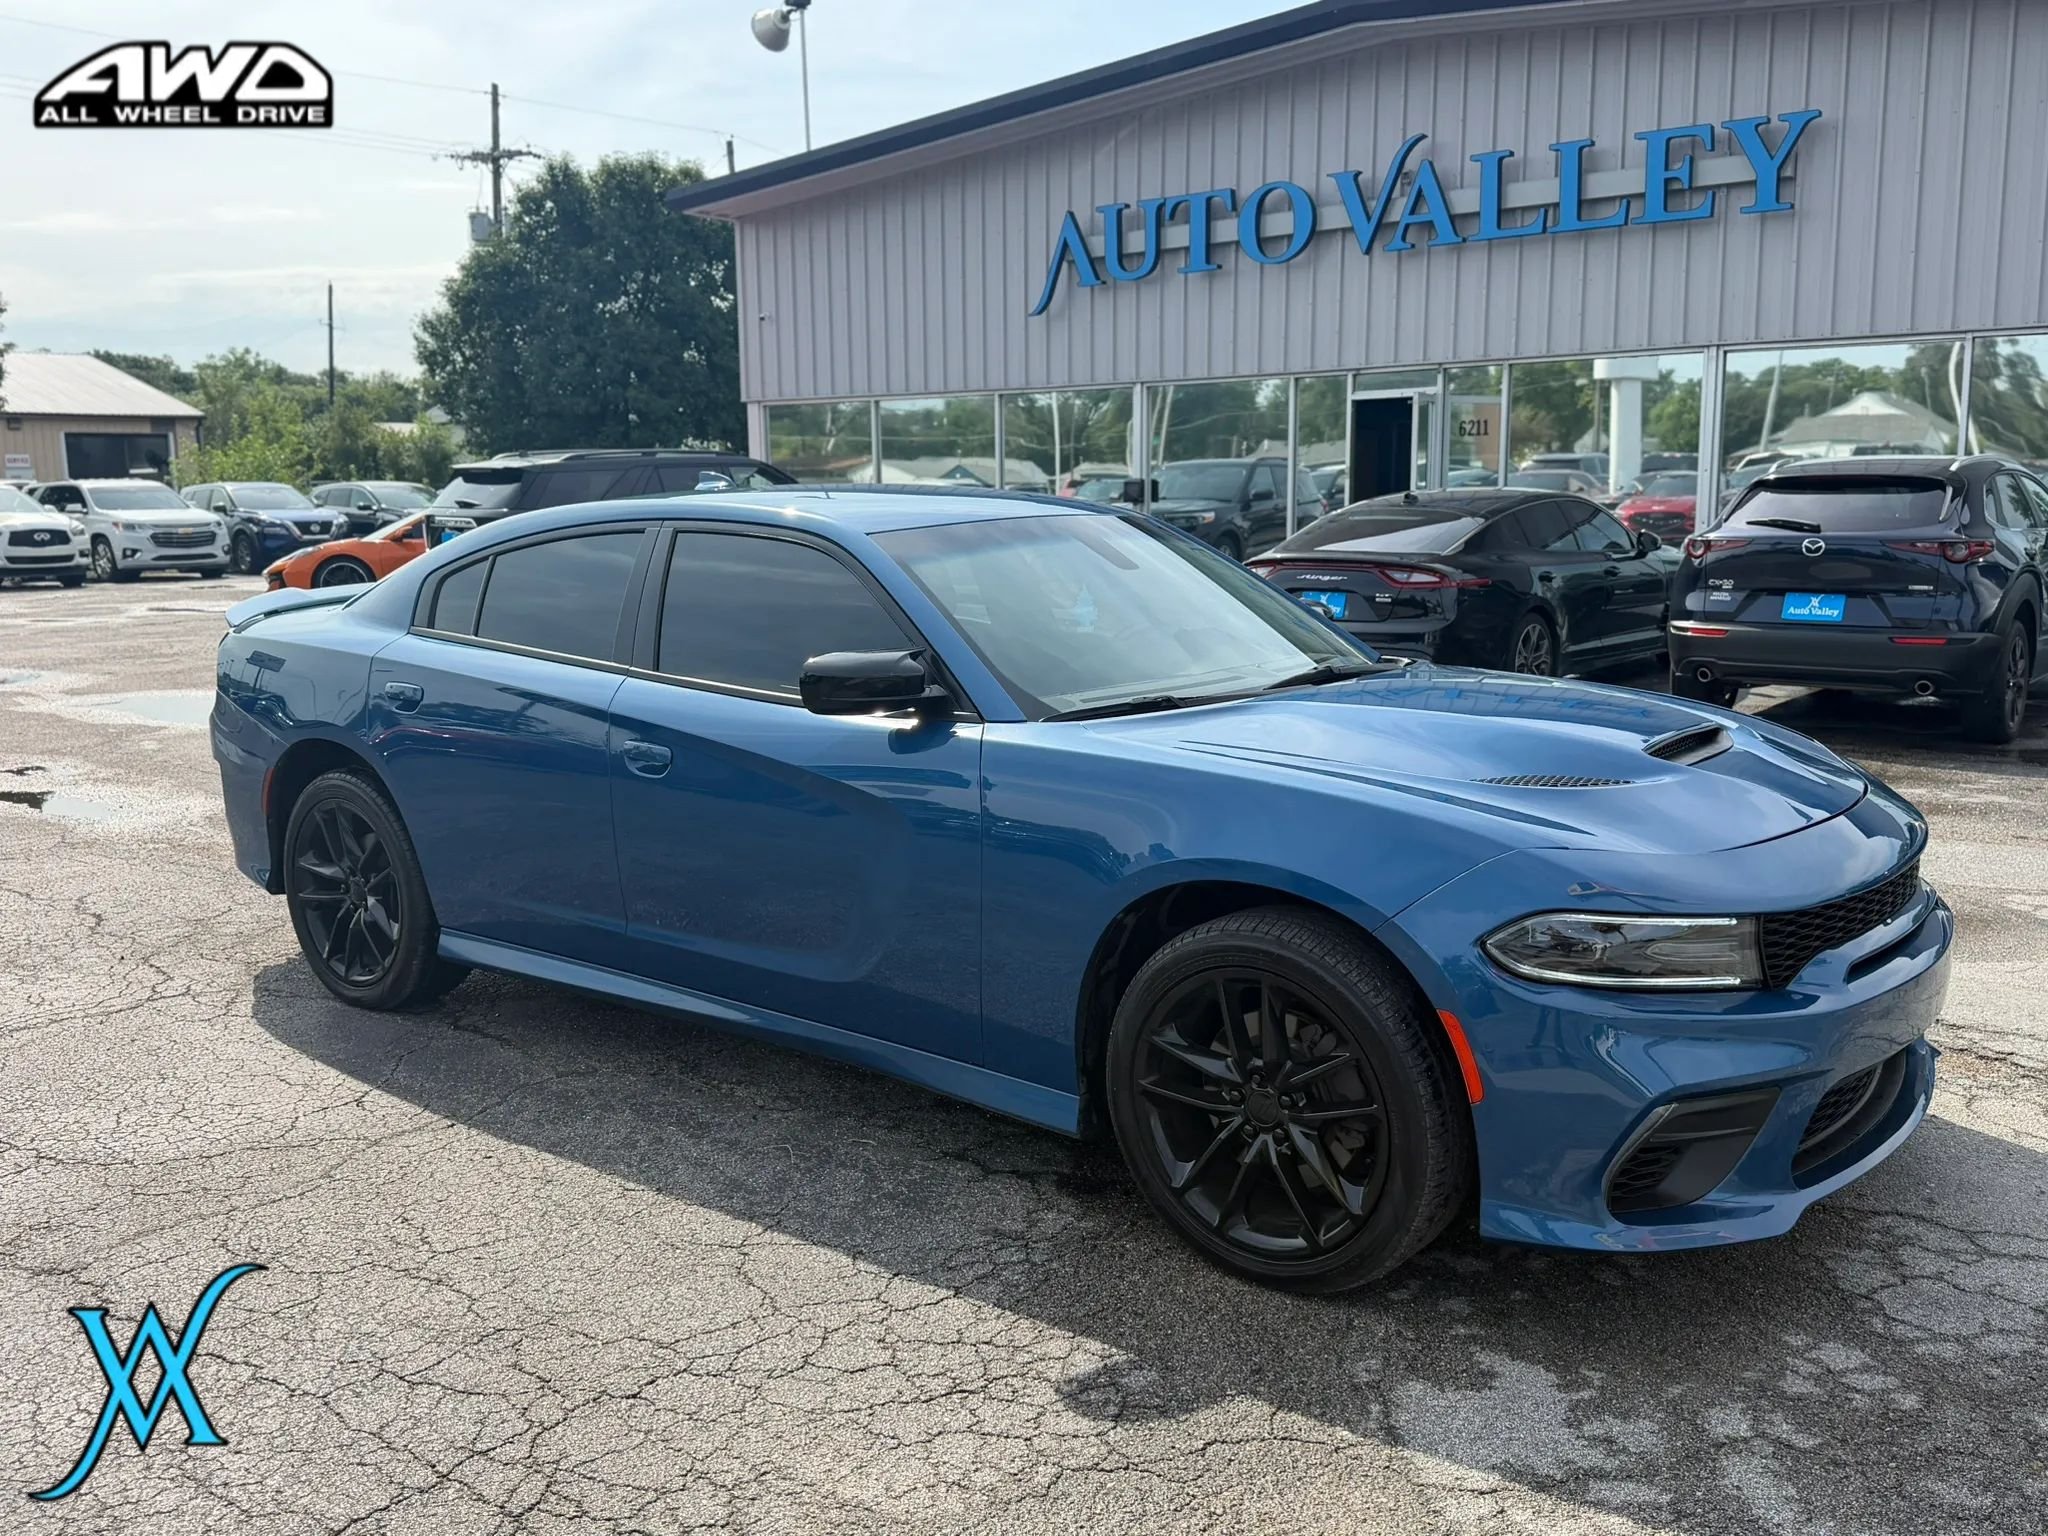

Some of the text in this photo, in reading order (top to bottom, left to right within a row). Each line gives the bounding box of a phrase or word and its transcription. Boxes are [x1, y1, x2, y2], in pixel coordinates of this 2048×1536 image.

[1028, 109, 1823, 317] AUTO VALLEY
[1459, 418, 1489, 437] 6211
[1787, 606, 1839, 618] Auto Valley
